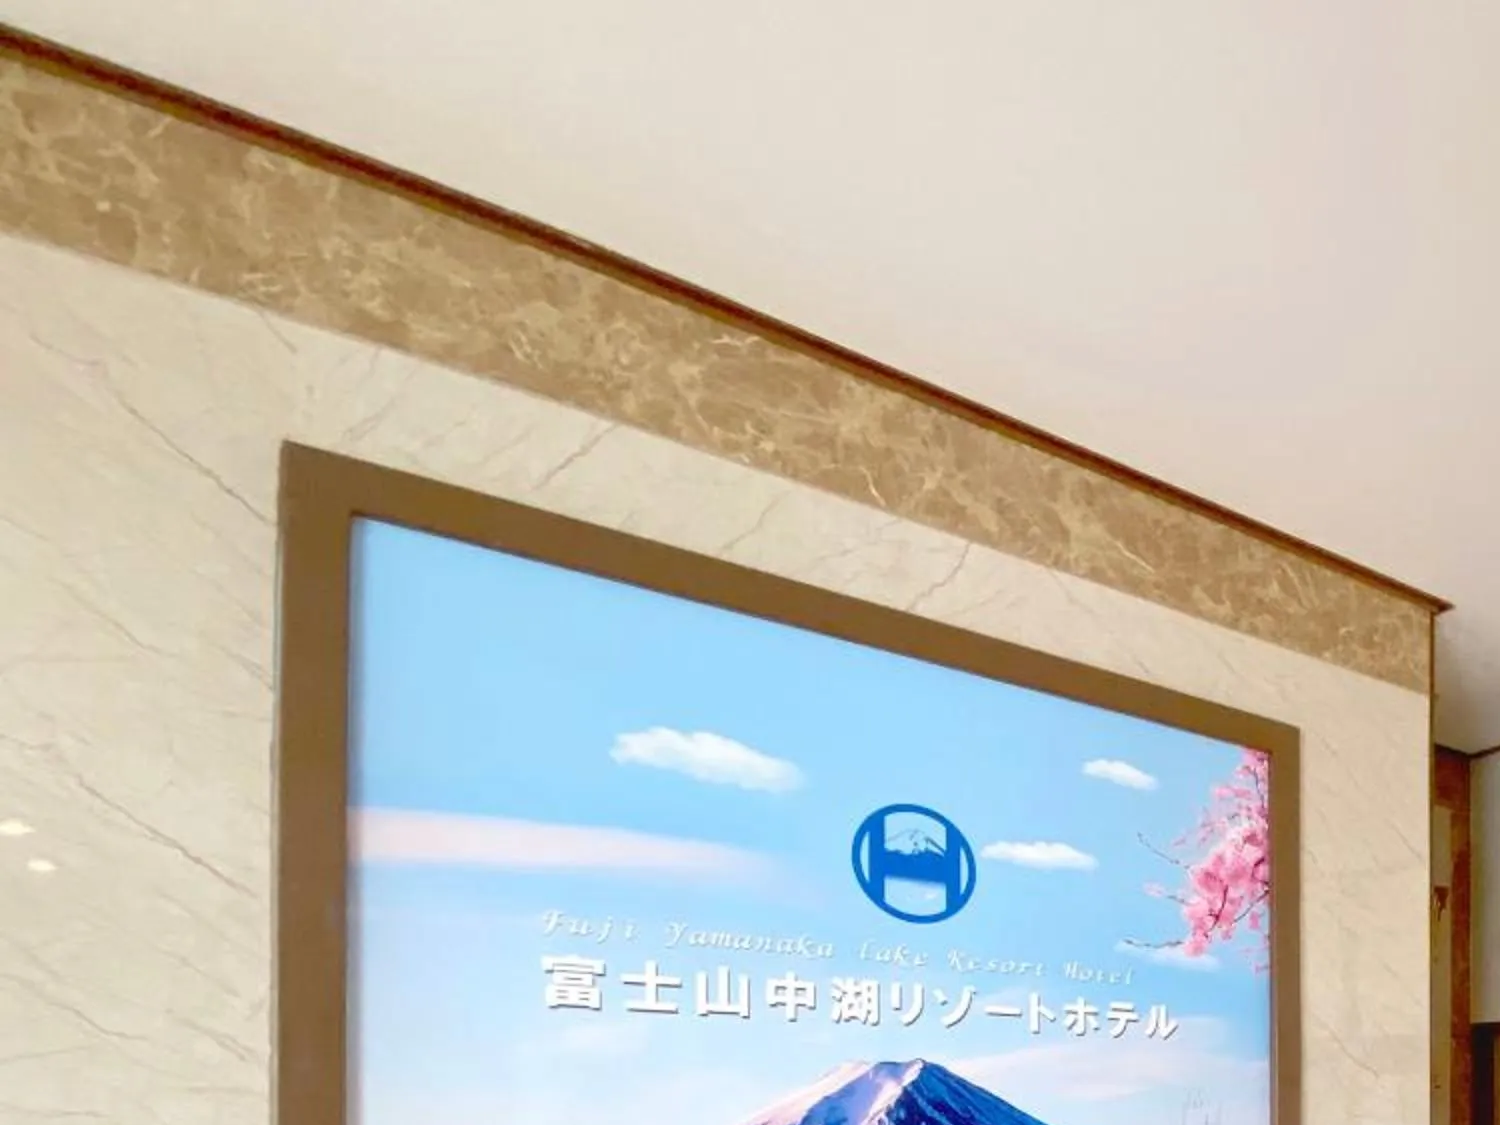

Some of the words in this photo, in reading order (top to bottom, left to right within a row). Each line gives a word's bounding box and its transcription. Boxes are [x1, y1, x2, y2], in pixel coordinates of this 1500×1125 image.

[543, 909, 638, 942] Fuji
[665, 919, 834, 958] Yamanaka
[947, 949, 1046, 976] Resort
[1064, 960, 1135, 986] Hotel
[541, 954, 1179, 1040] 富士山中湖リゾートホテル
